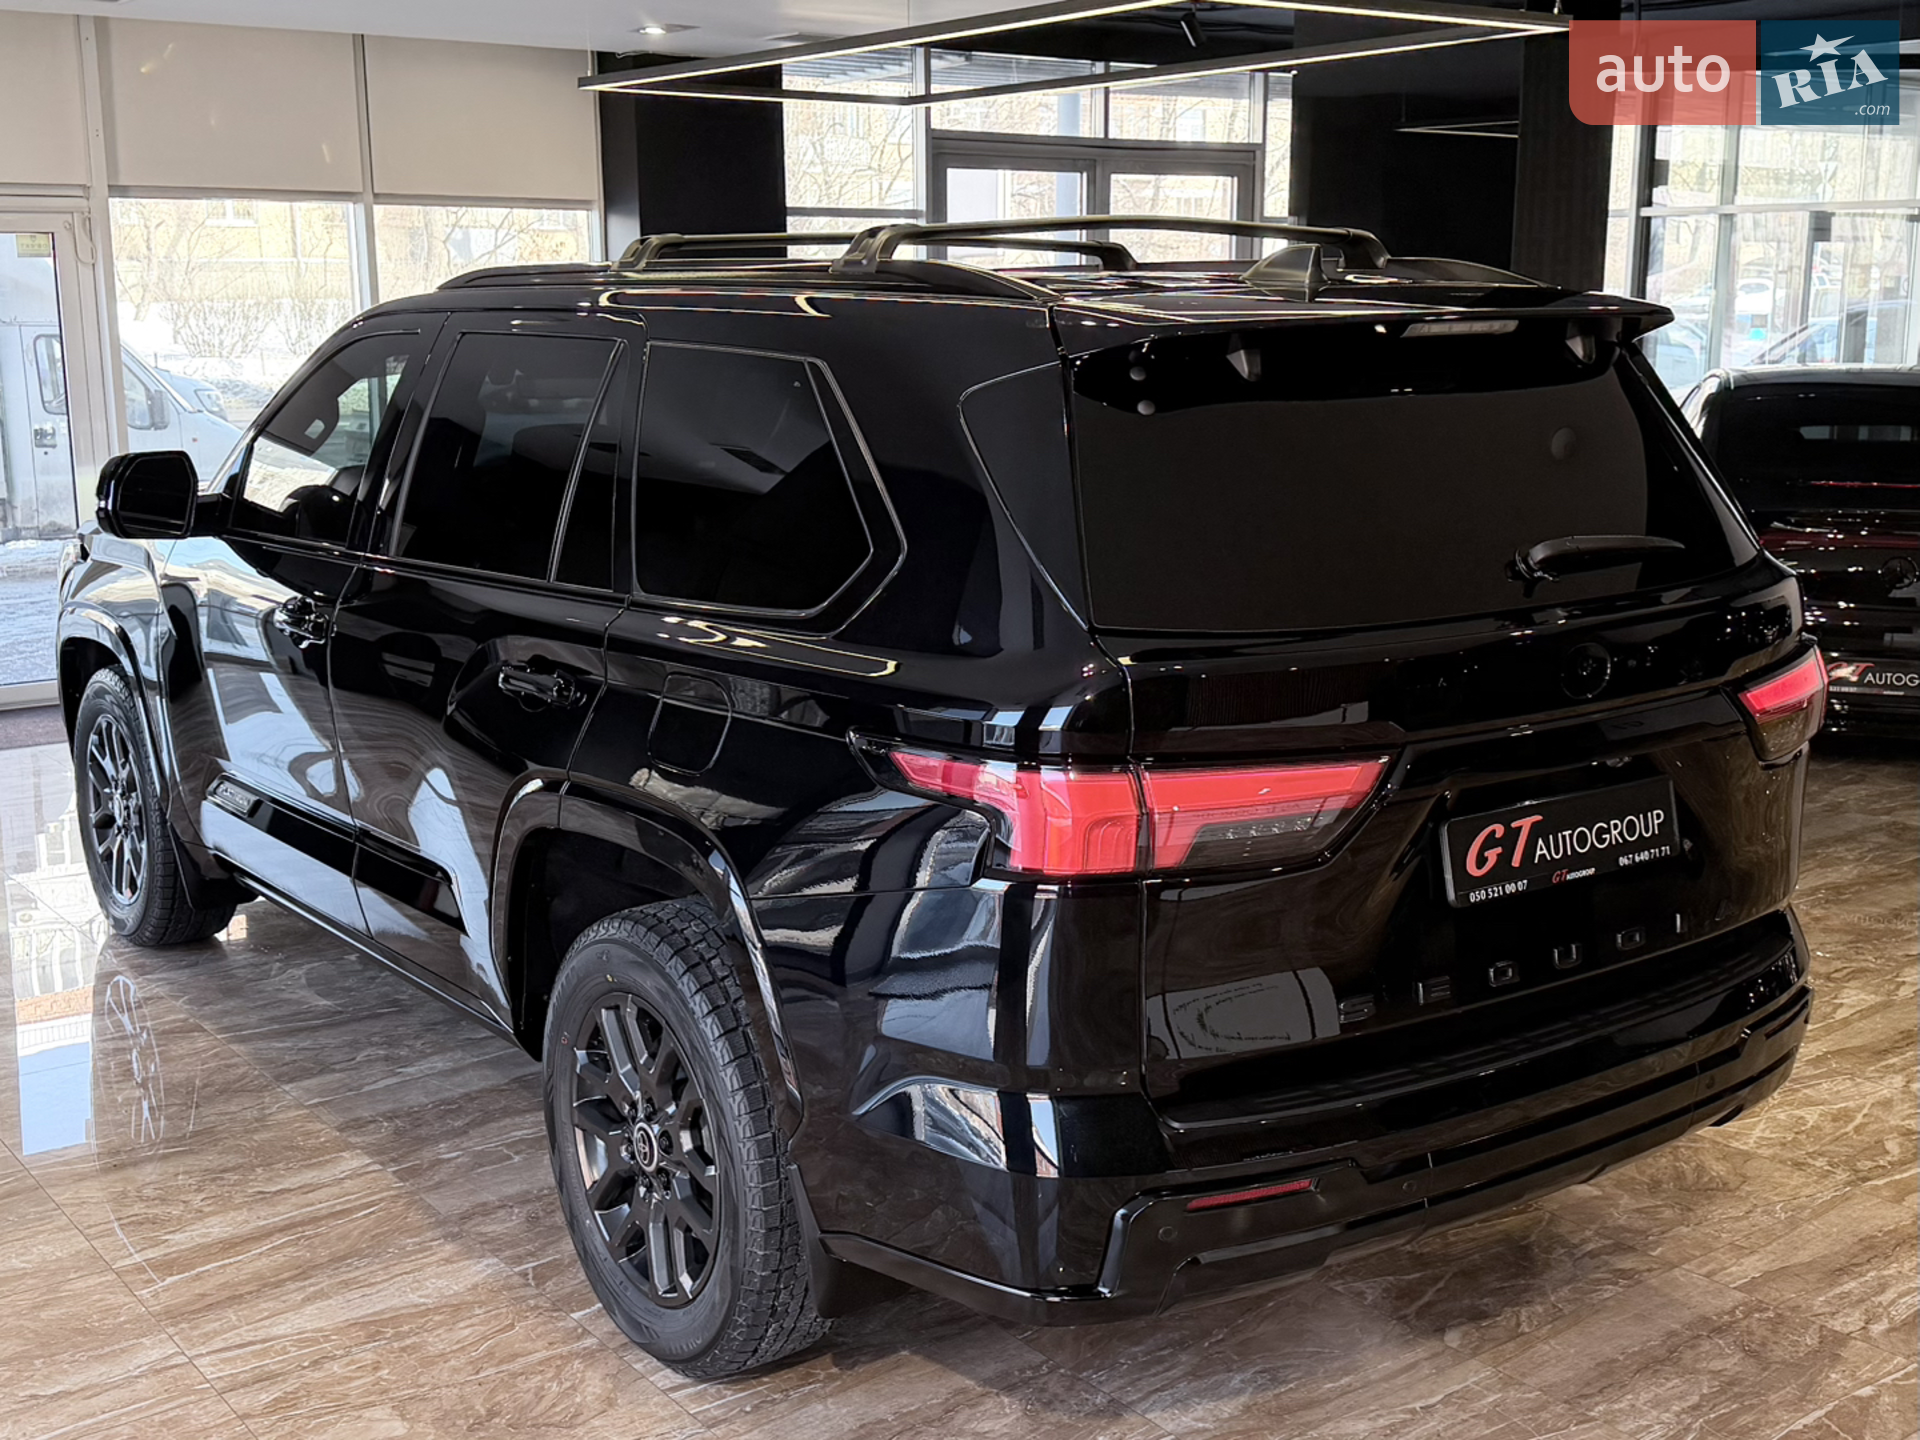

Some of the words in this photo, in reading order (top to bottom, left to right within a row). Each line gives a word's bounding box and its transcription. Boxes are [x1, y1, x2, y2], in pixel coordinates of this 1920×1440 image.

[1465, 814, 1543, 877] GT
[1534, 809, 1665, 864] AUTOGROUP
[1618, 854, 1633, 867] 067
[1634, 850, 1650, 863] 640
[1650, 848, 1660, 860] 71
[1660, 845, 1670, 857] 71
[1552, 868, 1569, 884] GT
[1469, 889, 1487, 903] 050
[1487, 885, 1503, 899] 521
[1504, 882, 1517, 895] 00
[1517, 879, 1528, 892] 07
